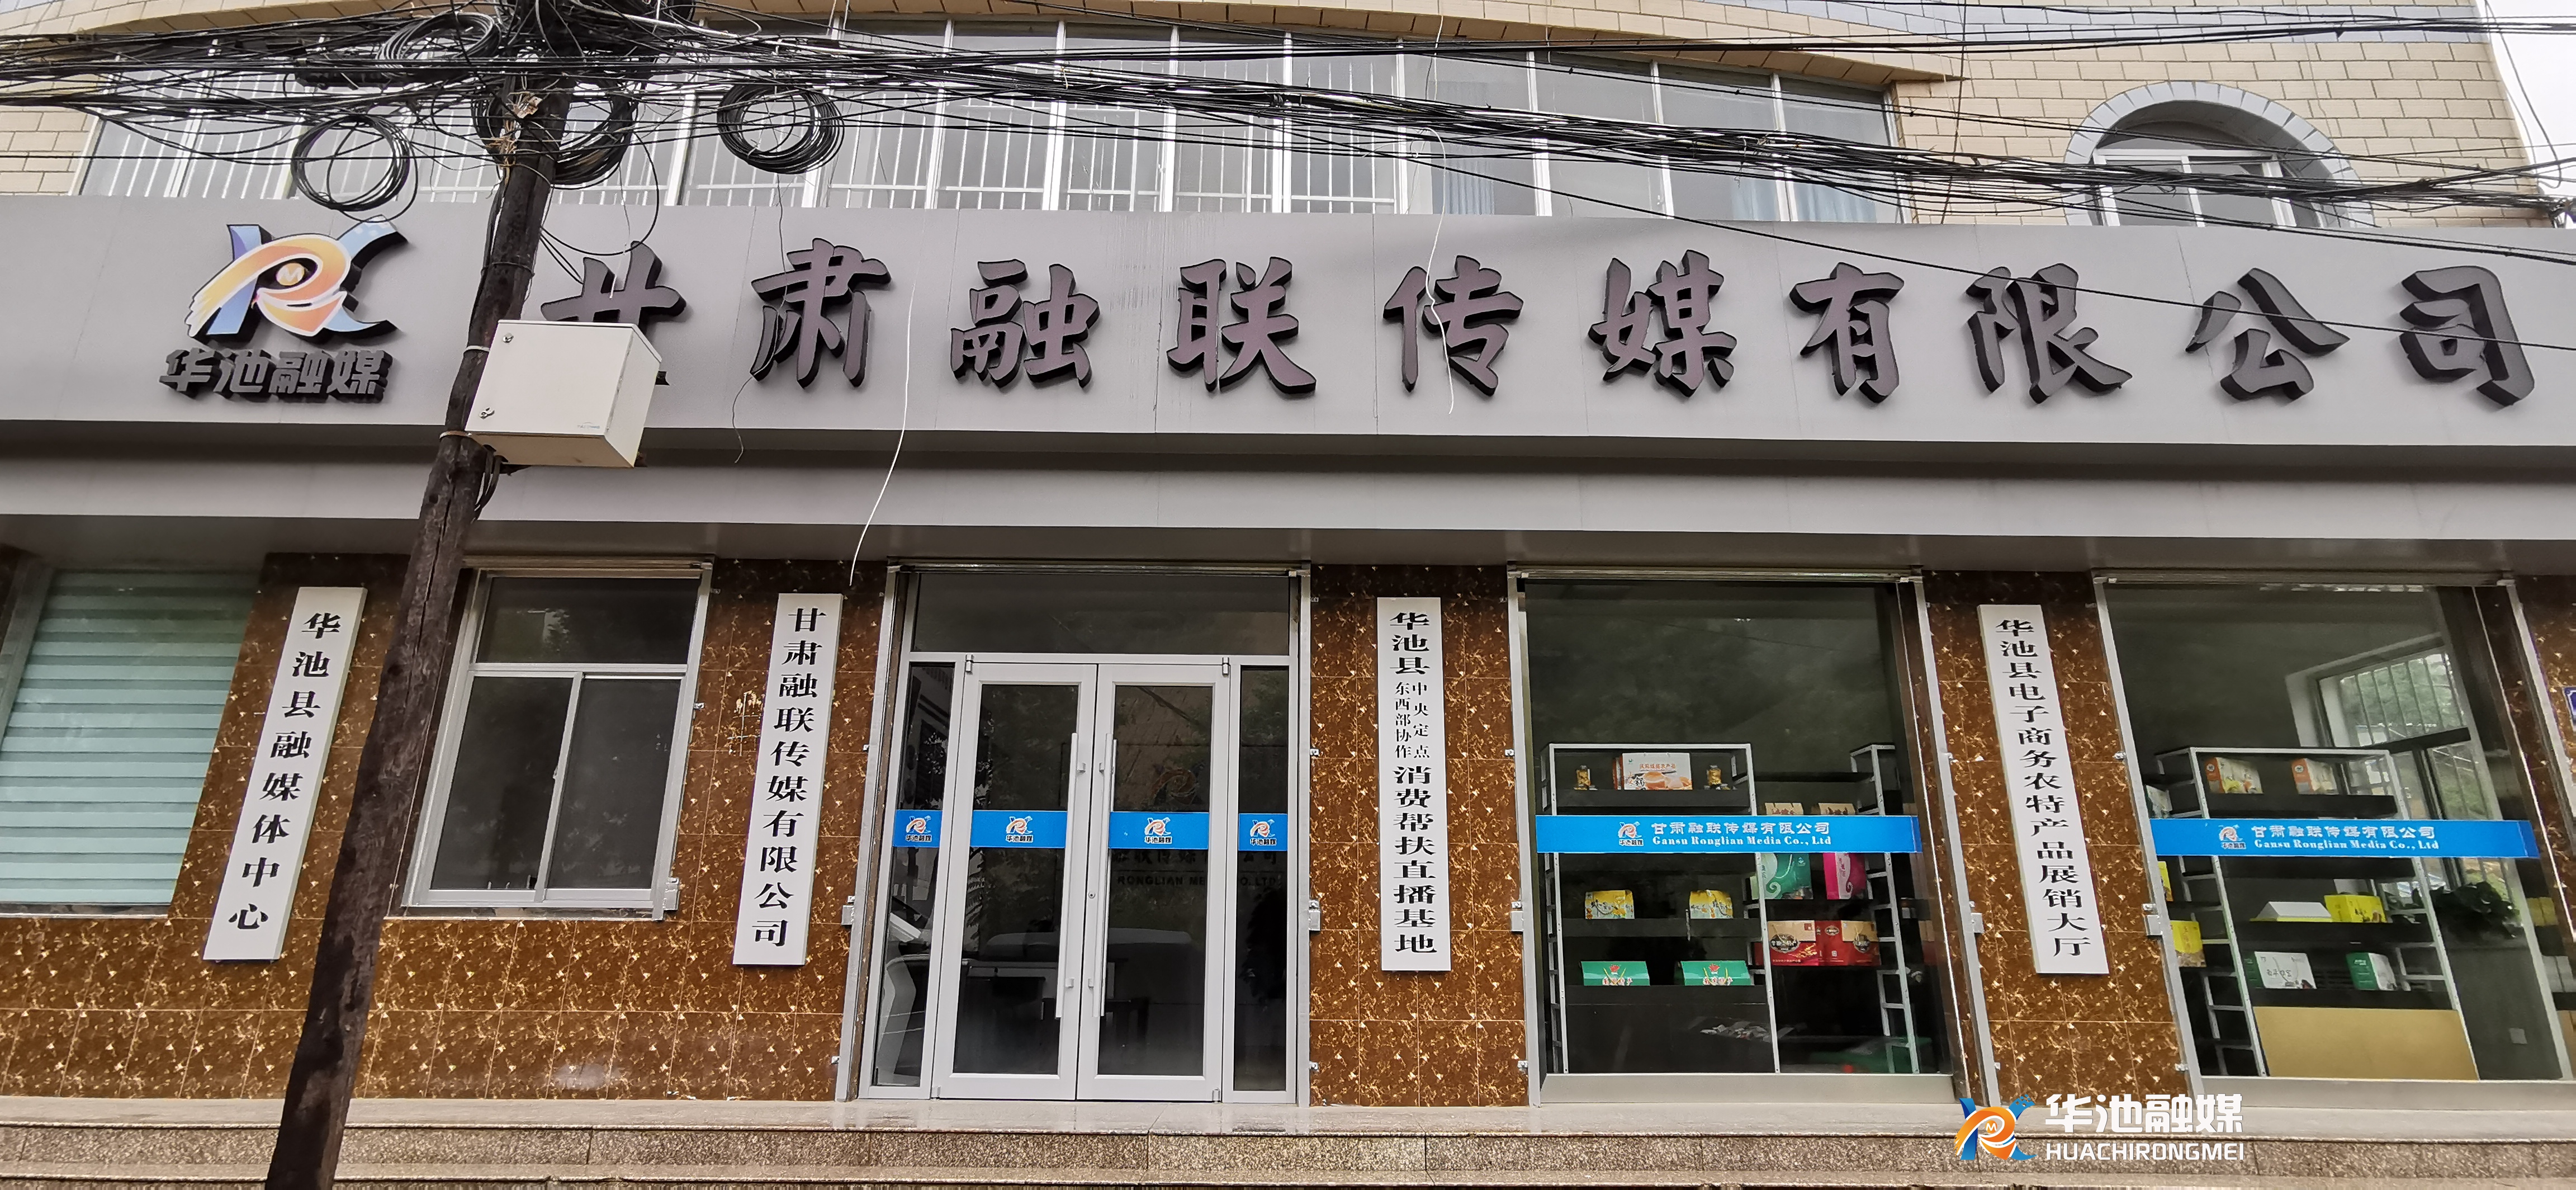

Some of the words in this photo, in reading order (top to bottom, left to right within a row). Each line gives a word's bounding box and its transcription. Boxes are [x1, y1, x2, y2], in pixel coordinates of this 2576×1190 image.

[159, 347, 392, 400] 华池融媒
[1390, 612, 1431, 675] 华池县
[1394, 682, 1412, 759] 东西部协作
[1412, 682, 1430, 759] 中央定点
[228, 612, 342, 931] 华池县融媒体中心
[752, 607, 826, 947] 甘肃融联传媒有限公司
[1995, 618, 2091, 958] 华池县电子商务农特产品展销大厅
[1392, 766, 1438, 953] 消费帮扶直播基地
[1651, 821, 1830, 835] 甘肃融联传媒有限公司
[1652, 836, 1688, 845] Gansu
[1691, 835, 1744, 847] Ronglian
[1746, 835, 1782, 845] Media
[2254, 839, 2291, 848] Gansu
